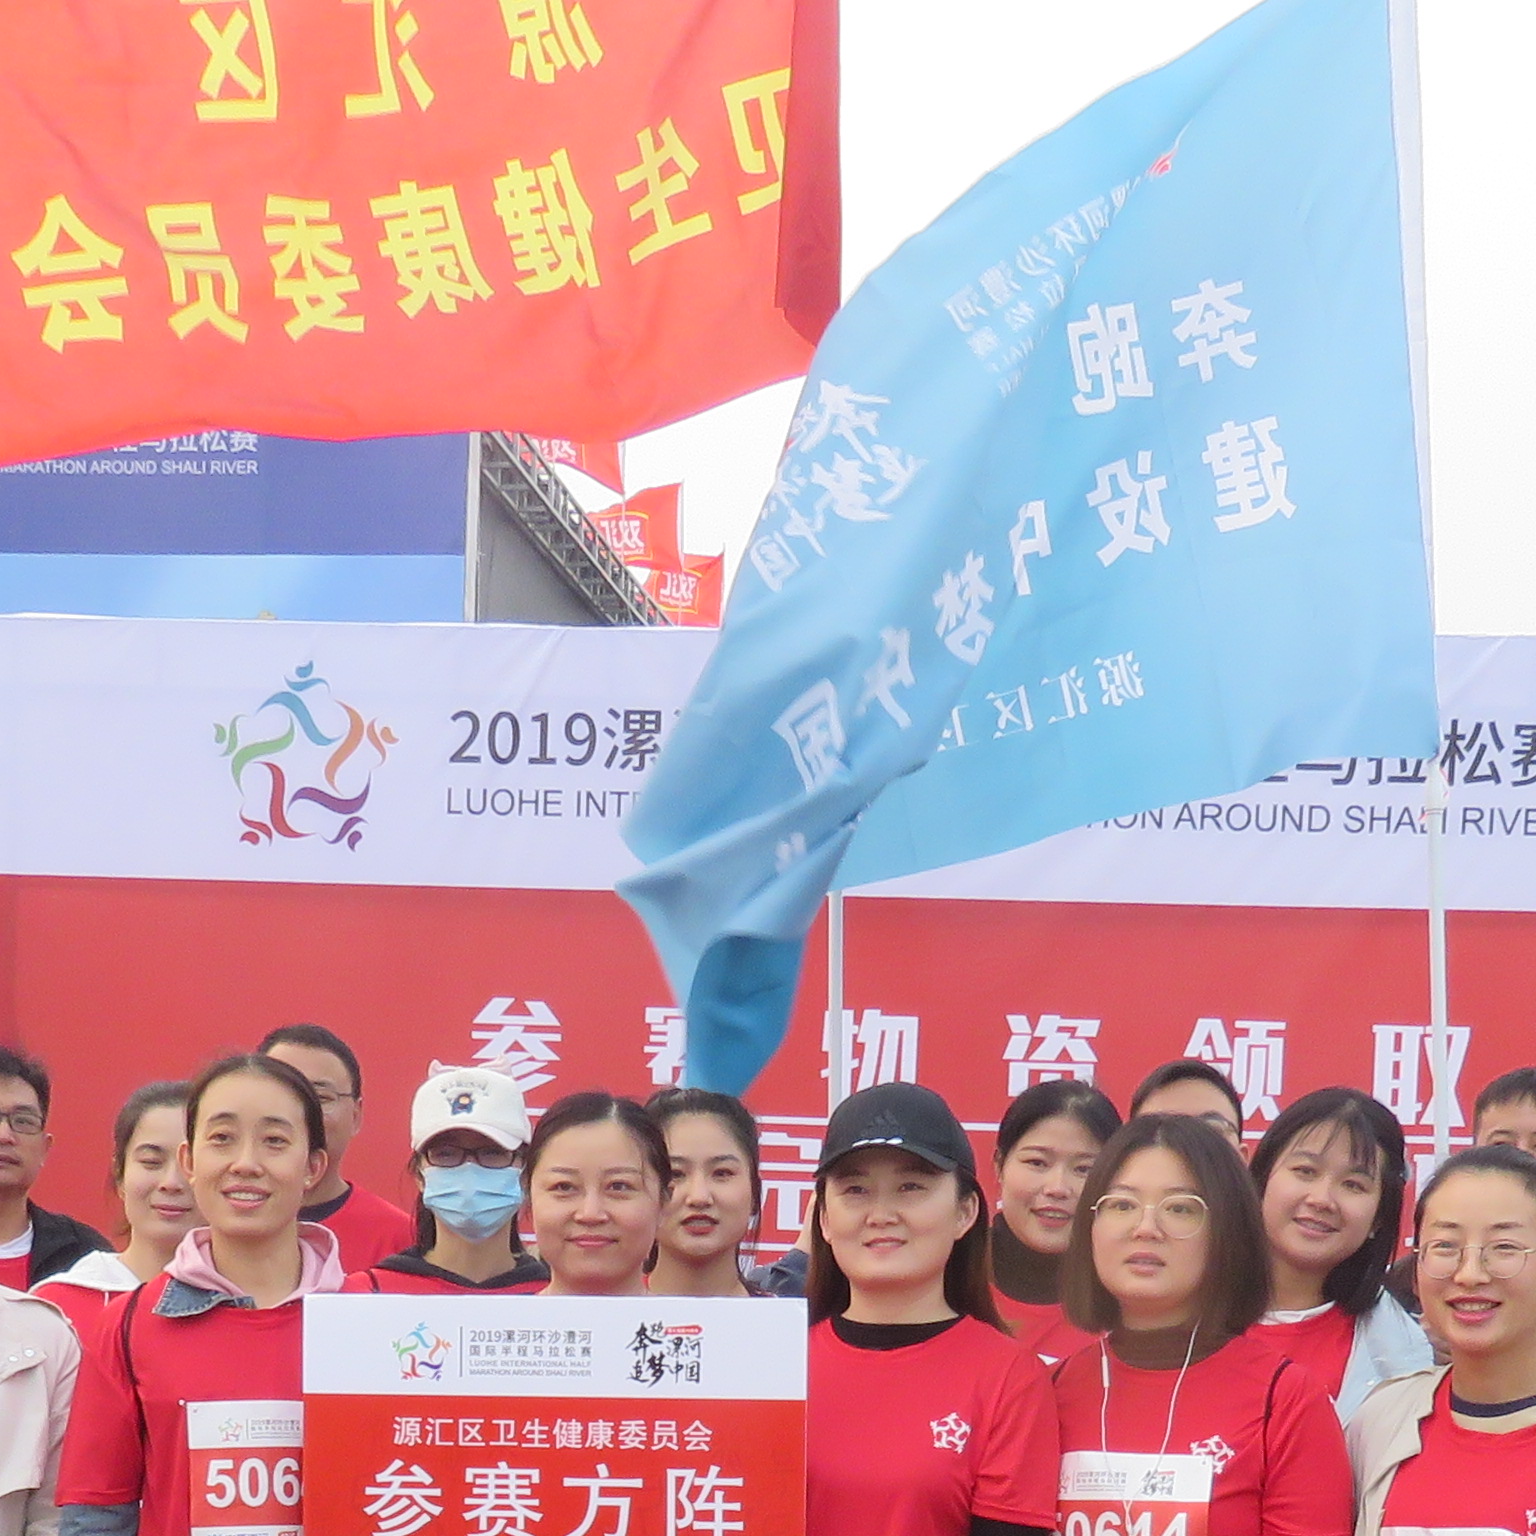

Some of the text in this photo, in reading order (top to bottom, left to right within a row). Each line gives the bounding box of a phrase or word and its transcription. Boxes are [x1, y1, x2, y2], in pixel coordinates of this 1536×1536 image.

[90, 459, 159, 475] AROUND
[162, 459, 207, 475] SHALI
[210, 459, 259, 475] RIVER
[447, 787, 563, 816] LUOHE
[1174, 802, 1331, 832] AROUND
[393, 1415, 714, 1452] 源汇区卫生健康委员会
[205, 1457, 304, 1508] 506
